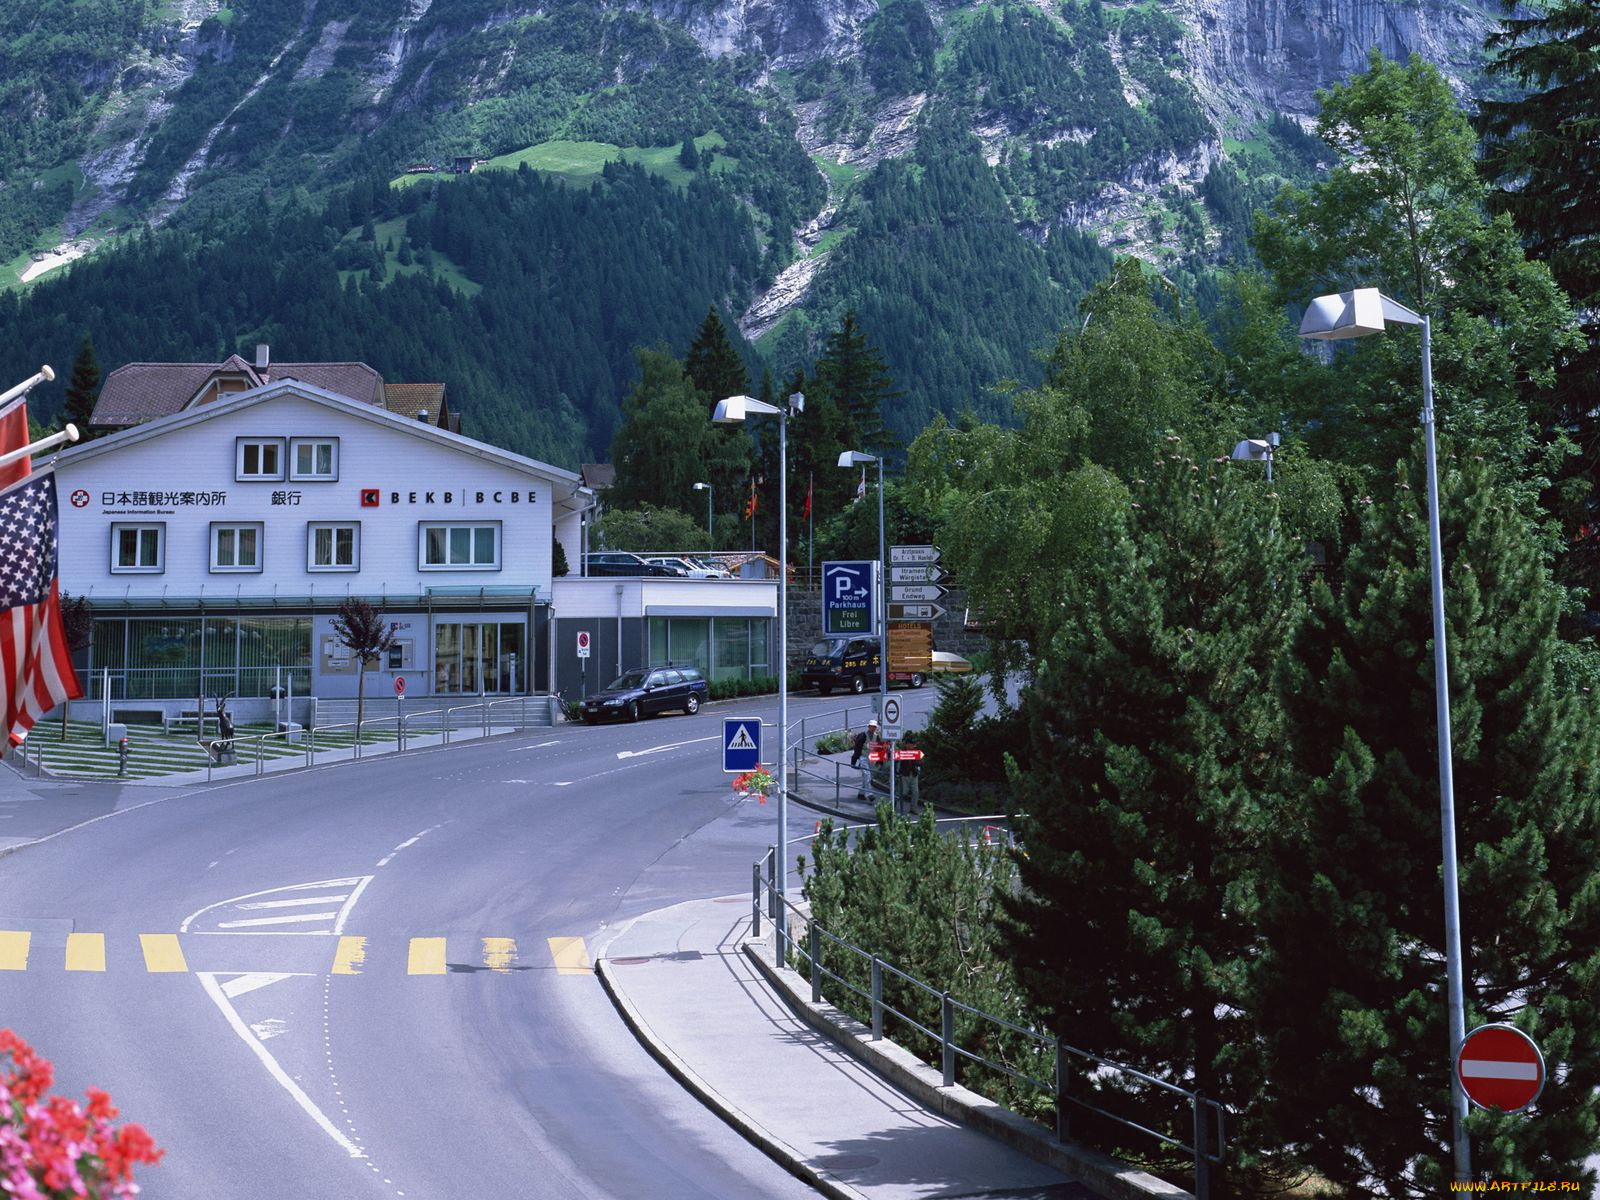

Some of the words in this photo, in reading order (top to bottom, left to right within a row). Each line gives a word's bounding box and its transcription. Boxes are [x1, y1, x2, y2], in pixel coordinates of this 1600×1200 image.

[101, 491, 227, 506] 日本語観光案内所
[271, 491, 302, 506] 銀行
[390, 491, 453, 504] BEKB
[475, 491, 537, 504] BCBE
[835, 576, 851, 599] P
[829, 601, 866, 609] Parkhaus
[842, 610, 858, 618] Frei
[839, 620, 860, 628] Libre
